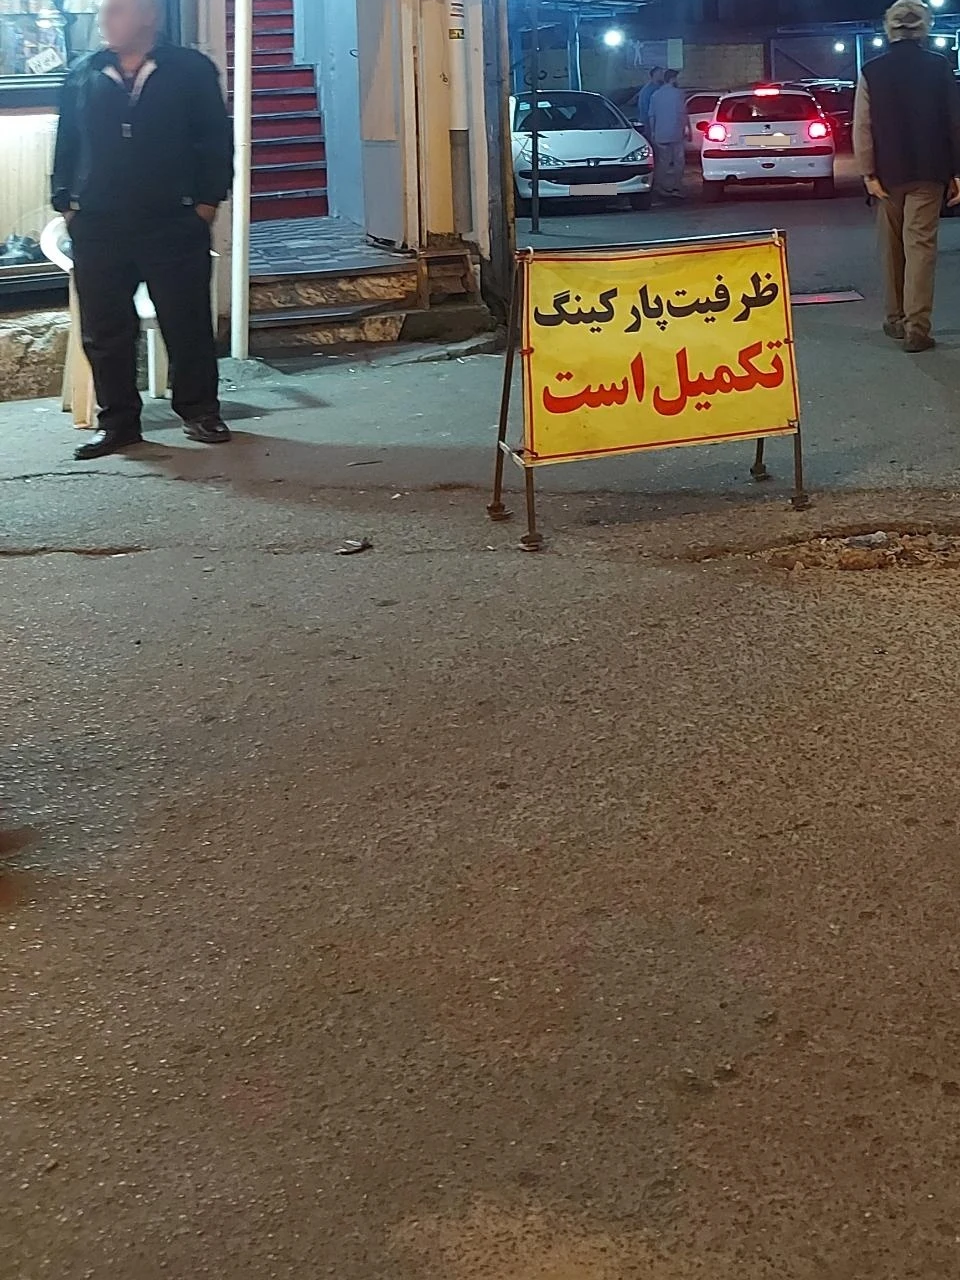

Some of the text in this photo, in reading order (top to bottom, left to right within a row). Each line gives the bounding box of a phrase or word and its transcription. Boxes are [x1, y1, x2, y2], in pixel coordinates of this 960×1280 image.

[534, 271, 780, 334] ظرفیت پارکینگ
[542, 339, 786, 418] تکمیل است
